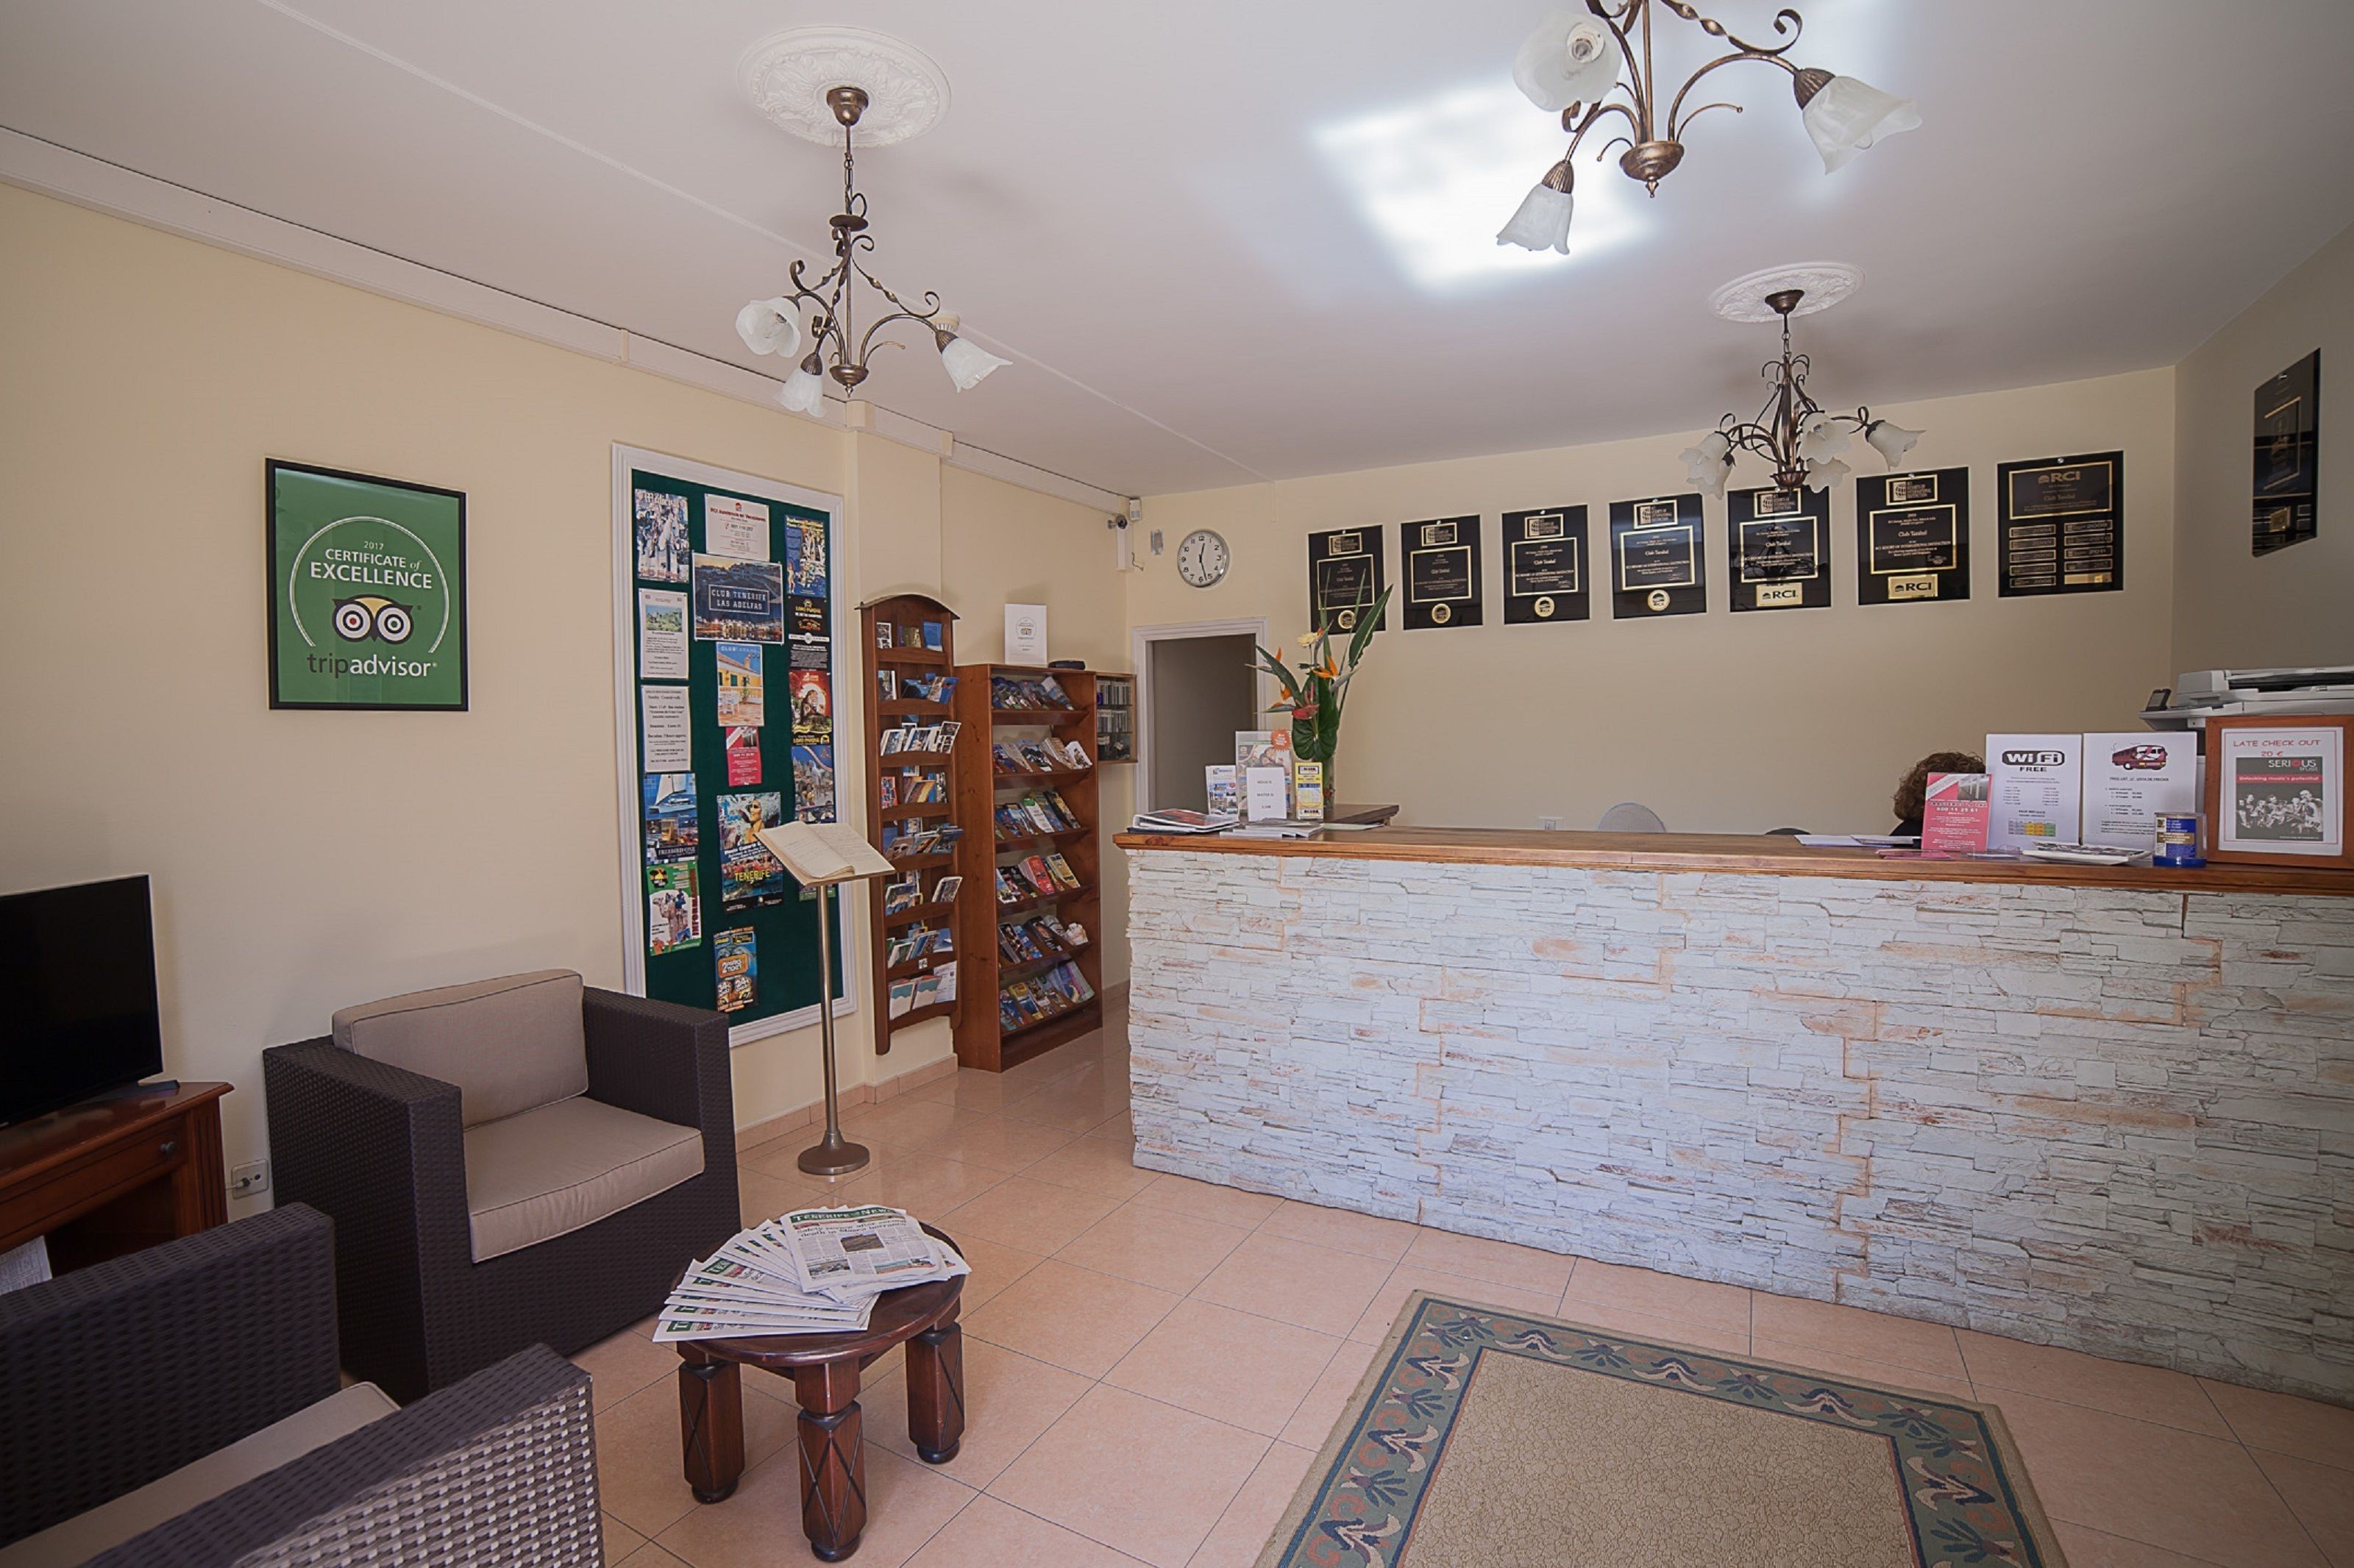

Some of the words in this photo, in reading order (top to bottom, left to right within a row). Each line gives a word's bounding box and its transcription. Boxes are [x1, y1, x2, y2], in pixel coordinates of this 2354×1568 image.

[2051, 471, 2080, 482] RCI
[363, 541, 384, 550] 2017
[325, 549, 406, 568] CERTIFICATE
[410, 560, 422, 571] of
[310, 561, 432, 589] EXCELLENCE
[1906, 582, 1932, 591] RCI
[711, 589, 730, 598] CLUB
[733, 591, 766, 601] TENERIFE
[1773, 590, 1796, 599] RCI
[733, 601, 763, 610] ADELFAS
[307, 653, 432, 678] tripadvisor
[2268, 759, 2317, 768] SERIOUS
[734, 870, 771, 882] TENERIFE
[796, 1213, 848, 1222] TENERIFE
